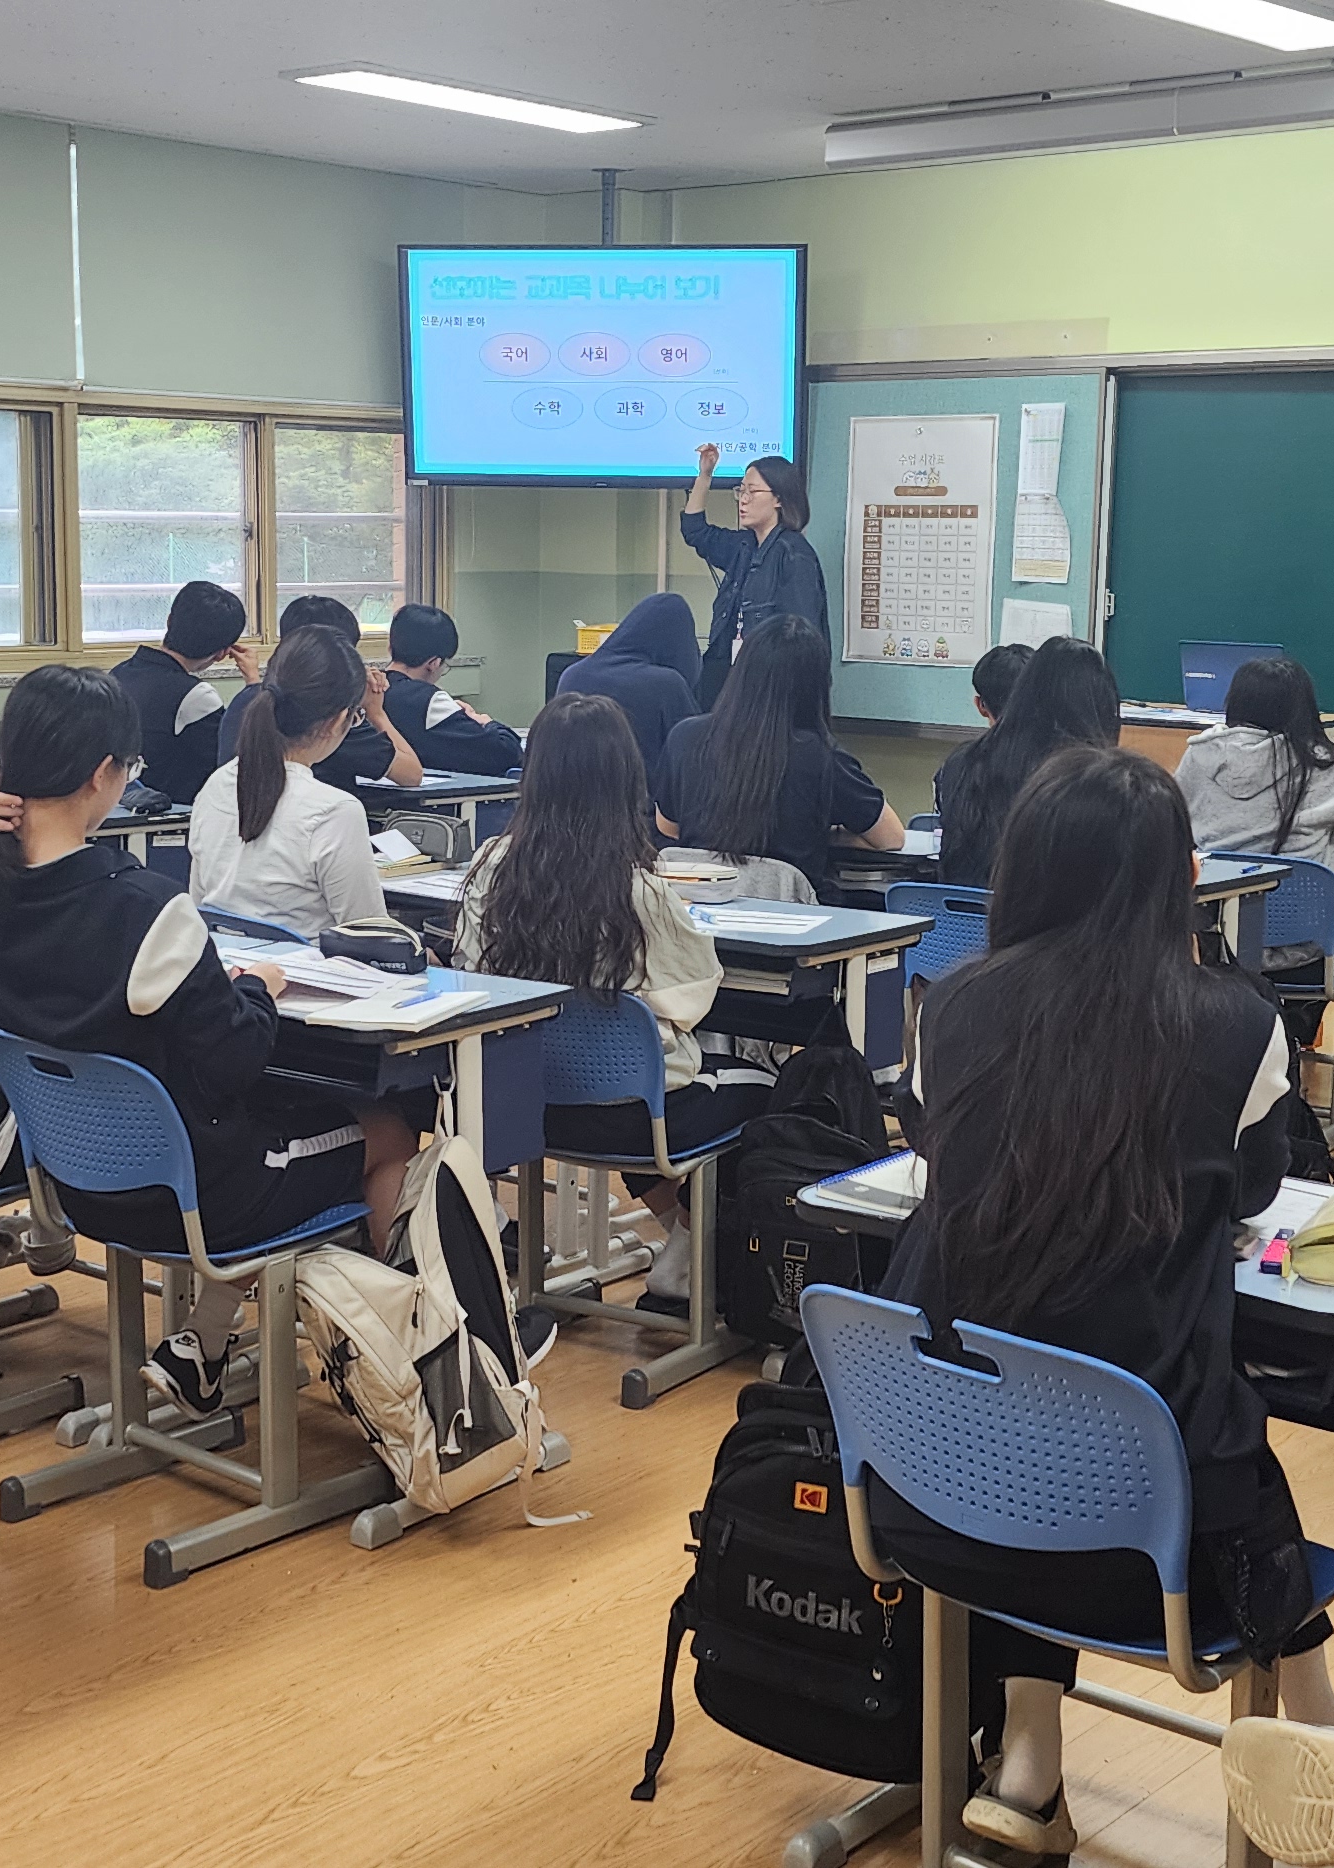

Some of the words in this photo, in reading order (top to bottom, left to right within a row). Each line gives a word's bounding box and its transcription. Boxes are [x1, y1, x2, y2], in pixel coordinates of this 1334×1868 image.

[430, 275, 517, 301] 선호하는
[525, 275, 592, 301] 교과목
[598, 275, 666, 301] 나누어
[674, 275, 720, 301] 보기
[421, 316, 463, 328] 인문/사회
[465, 316, 486, 328] 분야
[500, 346, 529, 363] 국어
[580, 345, 608, 362] 사회
[660, 346, 688, 363] 영어
[533, 401, 562, 416] 수학
[616, 401, 645, 416] 과학
[697, 401, 726, 416] 정보
[898, 454, 917, 466] 수업
[746, 1574, 864, 1636] Kodak
